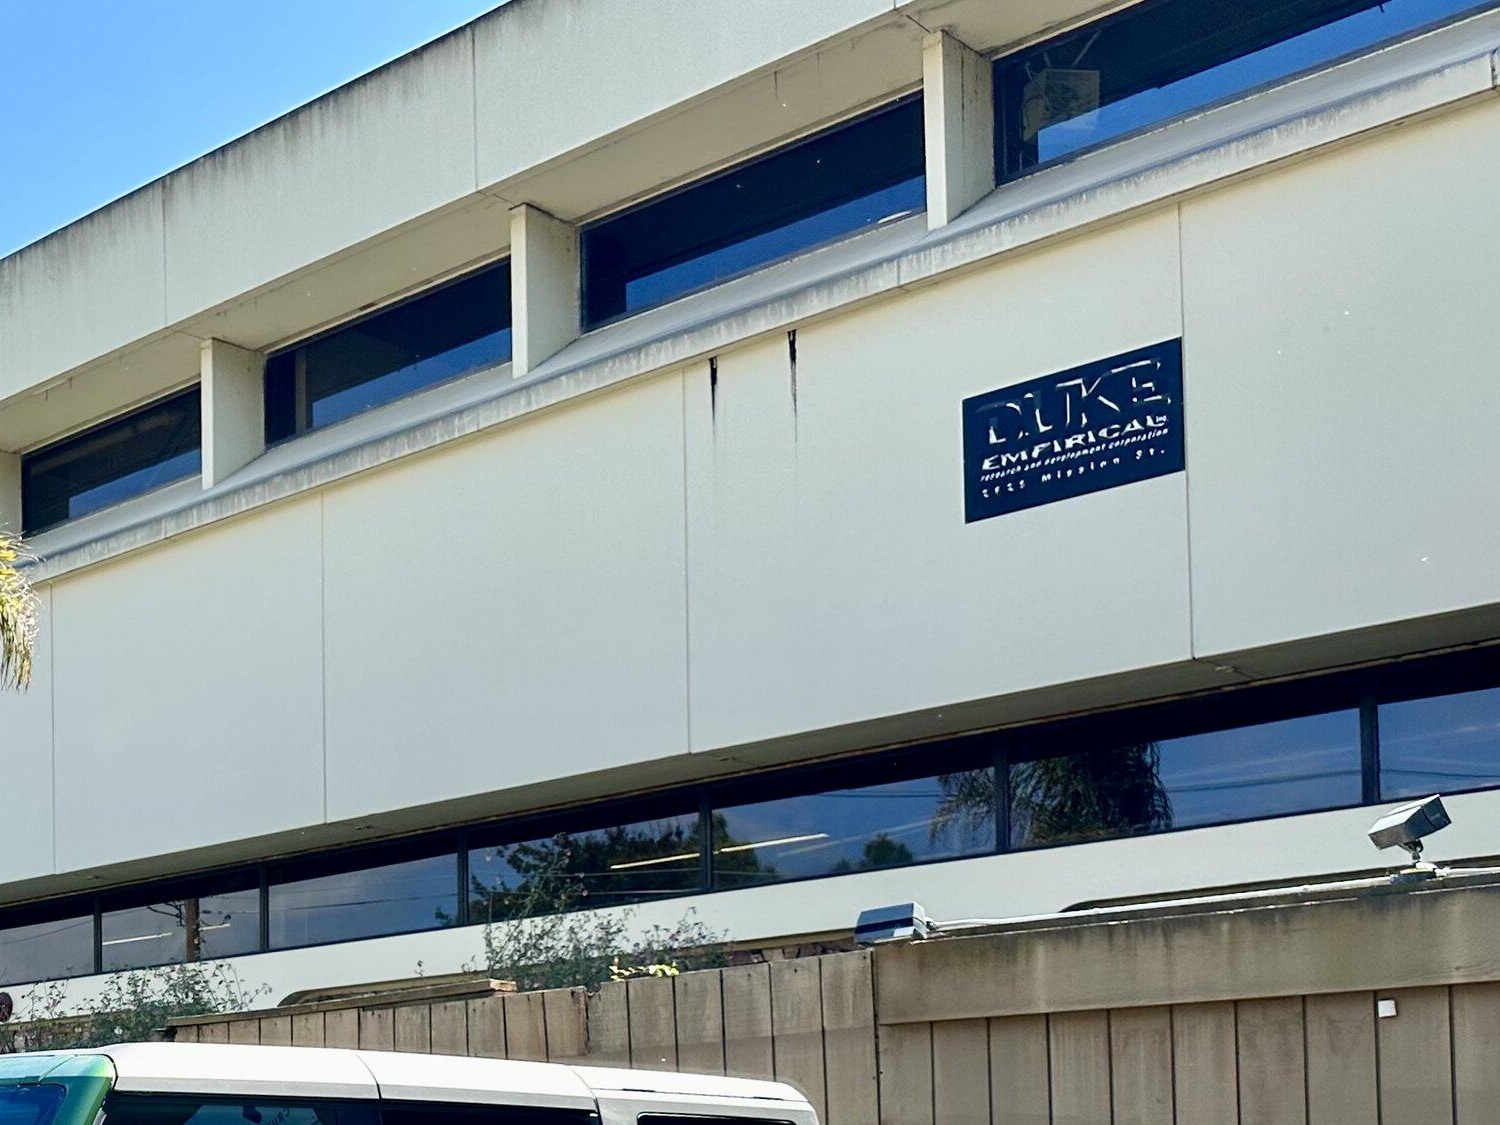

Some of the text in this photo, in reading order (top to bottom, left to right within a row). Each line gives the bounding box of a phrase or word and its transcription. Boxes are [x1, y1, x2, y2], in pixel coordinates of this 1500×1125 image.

[979, 427, 1169, 483] research and development corporation
[981, 415, 1166, 471] EMPIRICAL
